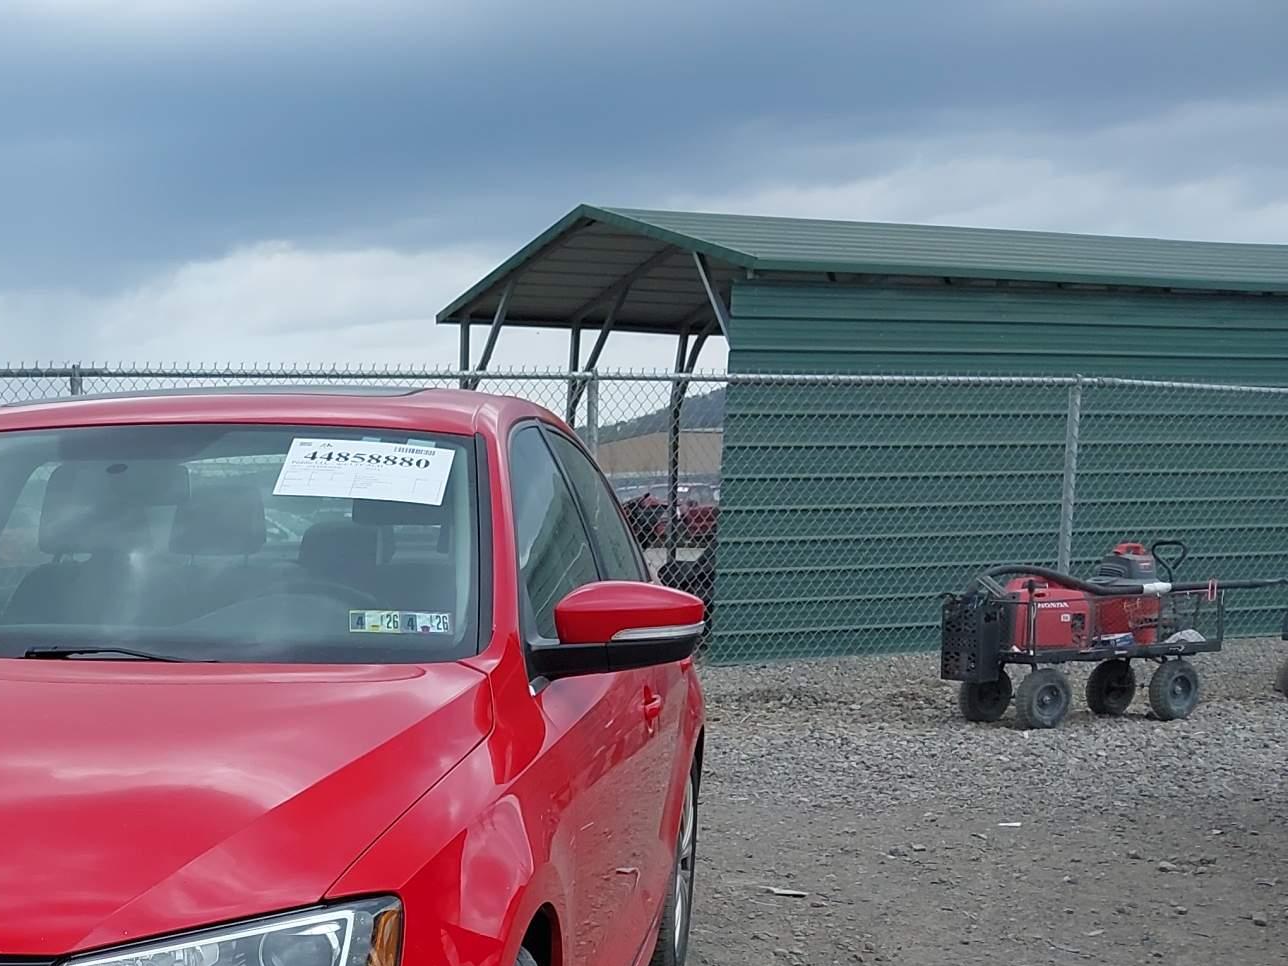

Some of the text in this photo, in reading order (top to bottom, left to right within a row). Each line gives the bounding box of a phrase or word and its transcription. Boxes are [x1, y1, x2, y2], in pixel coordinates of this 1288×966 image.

[303, 450, 431, 469] 44858880
[356, 614, 399, 630] 4 26
[407, 615, 449, 631] 4 26
